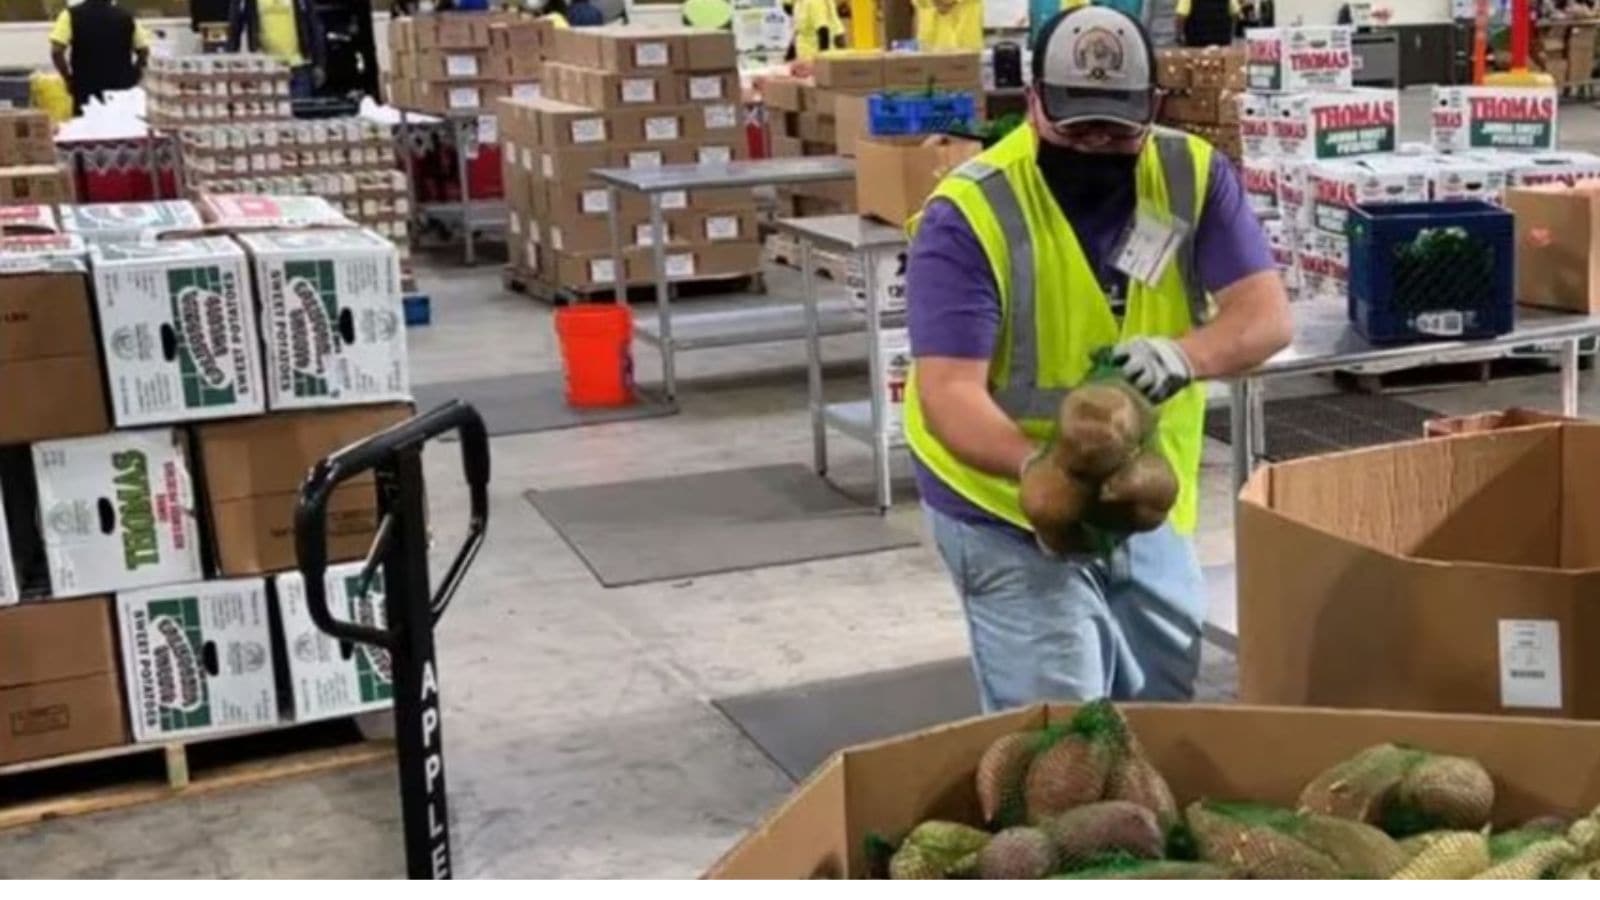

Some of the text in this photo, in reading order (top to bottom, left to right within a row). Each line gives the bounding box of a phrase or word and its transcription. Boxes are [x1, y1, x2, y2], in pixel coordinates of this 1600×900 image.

[1289, 47, 1350, 71] THOMAS
[1310, 100, 1396, 132] THOMAS
[1468, 96, 1553, 121] THOMAS
[222, 271, 249, 395] SWEET POTATOES
[270, 269, 291, 392] SWEET POTATOES
[111, 449, 159, 571] THOMAS
[133, 609, 157, 728] SWEET POTATOES
[421, 659, 448, 879] APPLE
